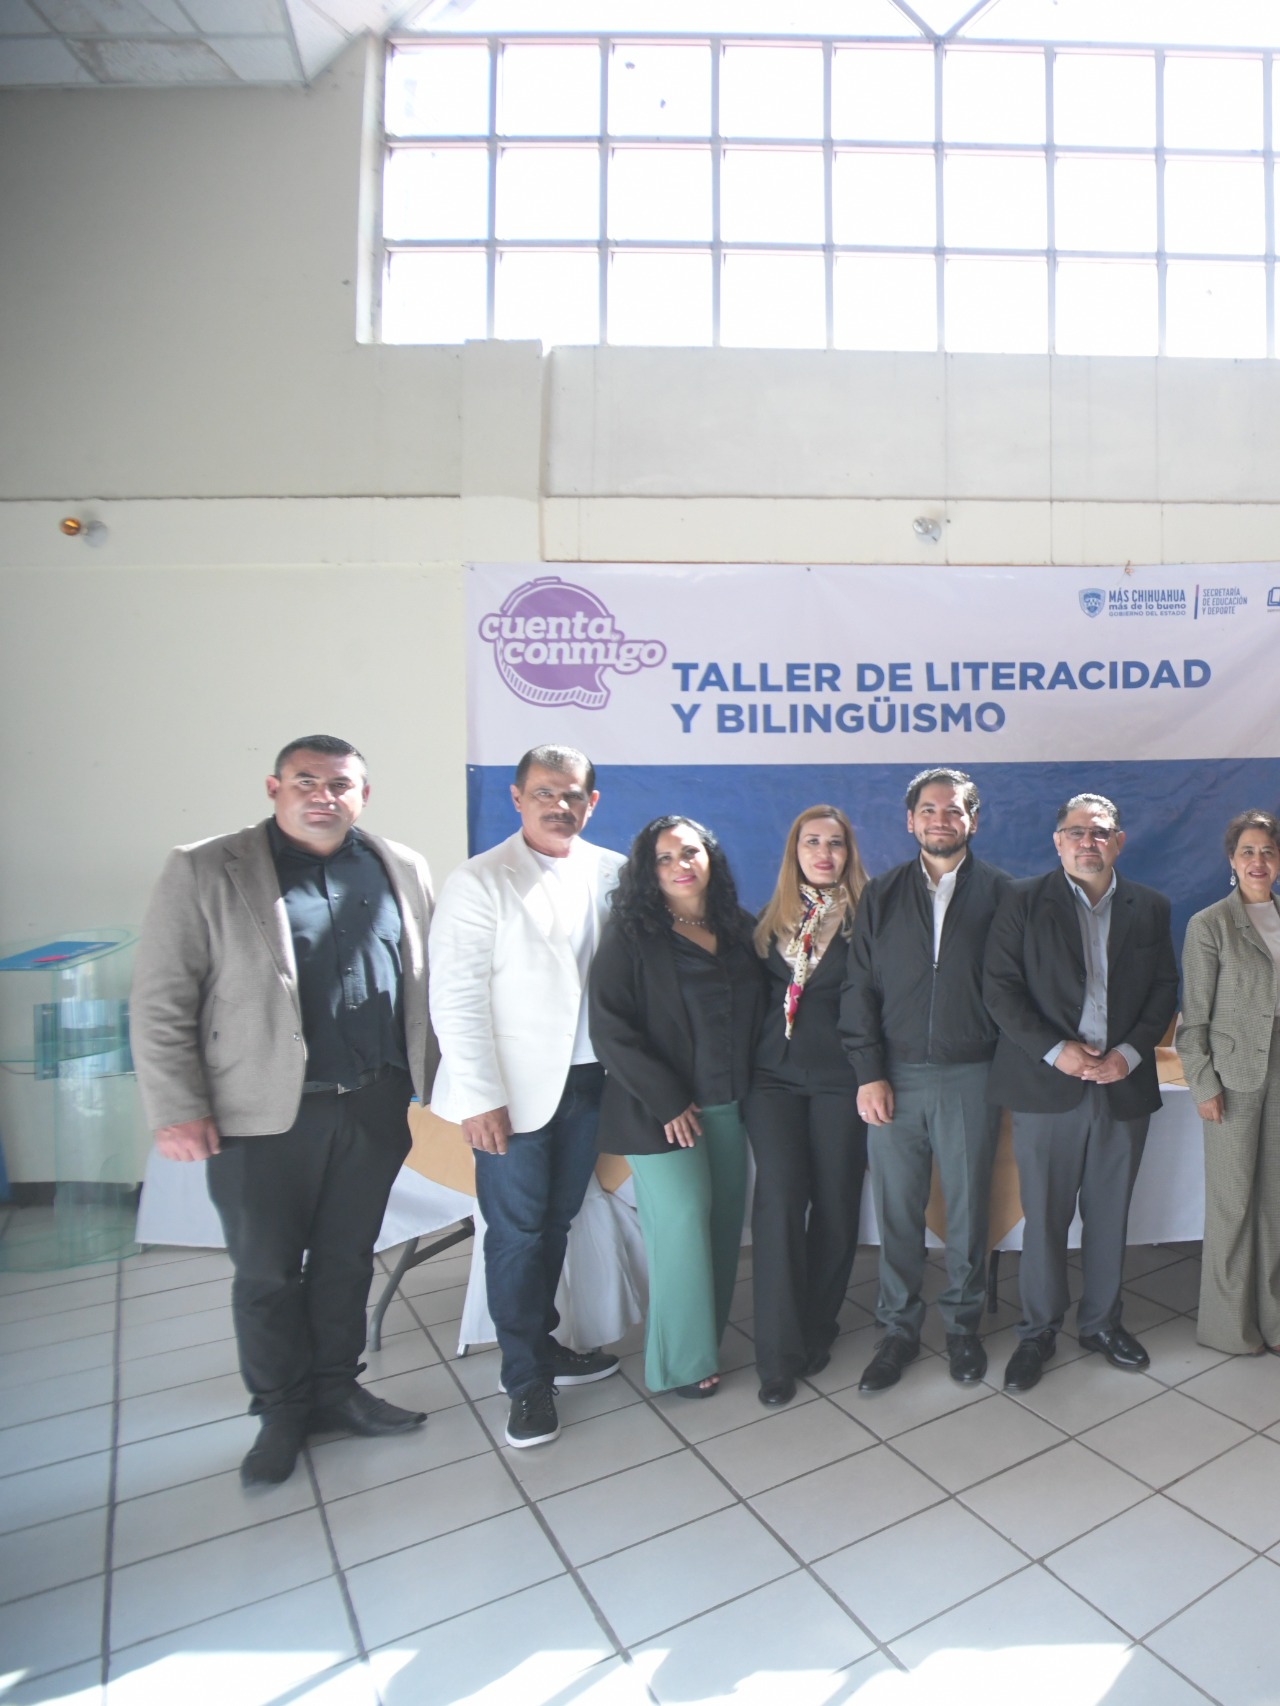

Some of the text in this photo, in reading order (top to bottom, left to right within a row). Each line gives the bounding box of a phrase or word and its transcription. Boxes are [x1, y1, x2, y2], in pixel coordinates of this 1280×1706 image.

[1108, 587, 1186, 603] MÁS CHIHUAHUA
[1202, 586, 1241, 597] SECRETARÍA
[1108, 601, 1187, 610] más de lo bueno
[1202, 595, 1248, 606] DE EDUCACIÓN
[1201, 605, 1236, 615] Y DEPORTE
[480, 611, 613, 641] cuenta
[502, 638, 664, 672] conmigo
[671, 659, 1212, 692] TALLER DE LITERACIDAD
[670, 695, 1006, 734] Y BILINGÜISMO
